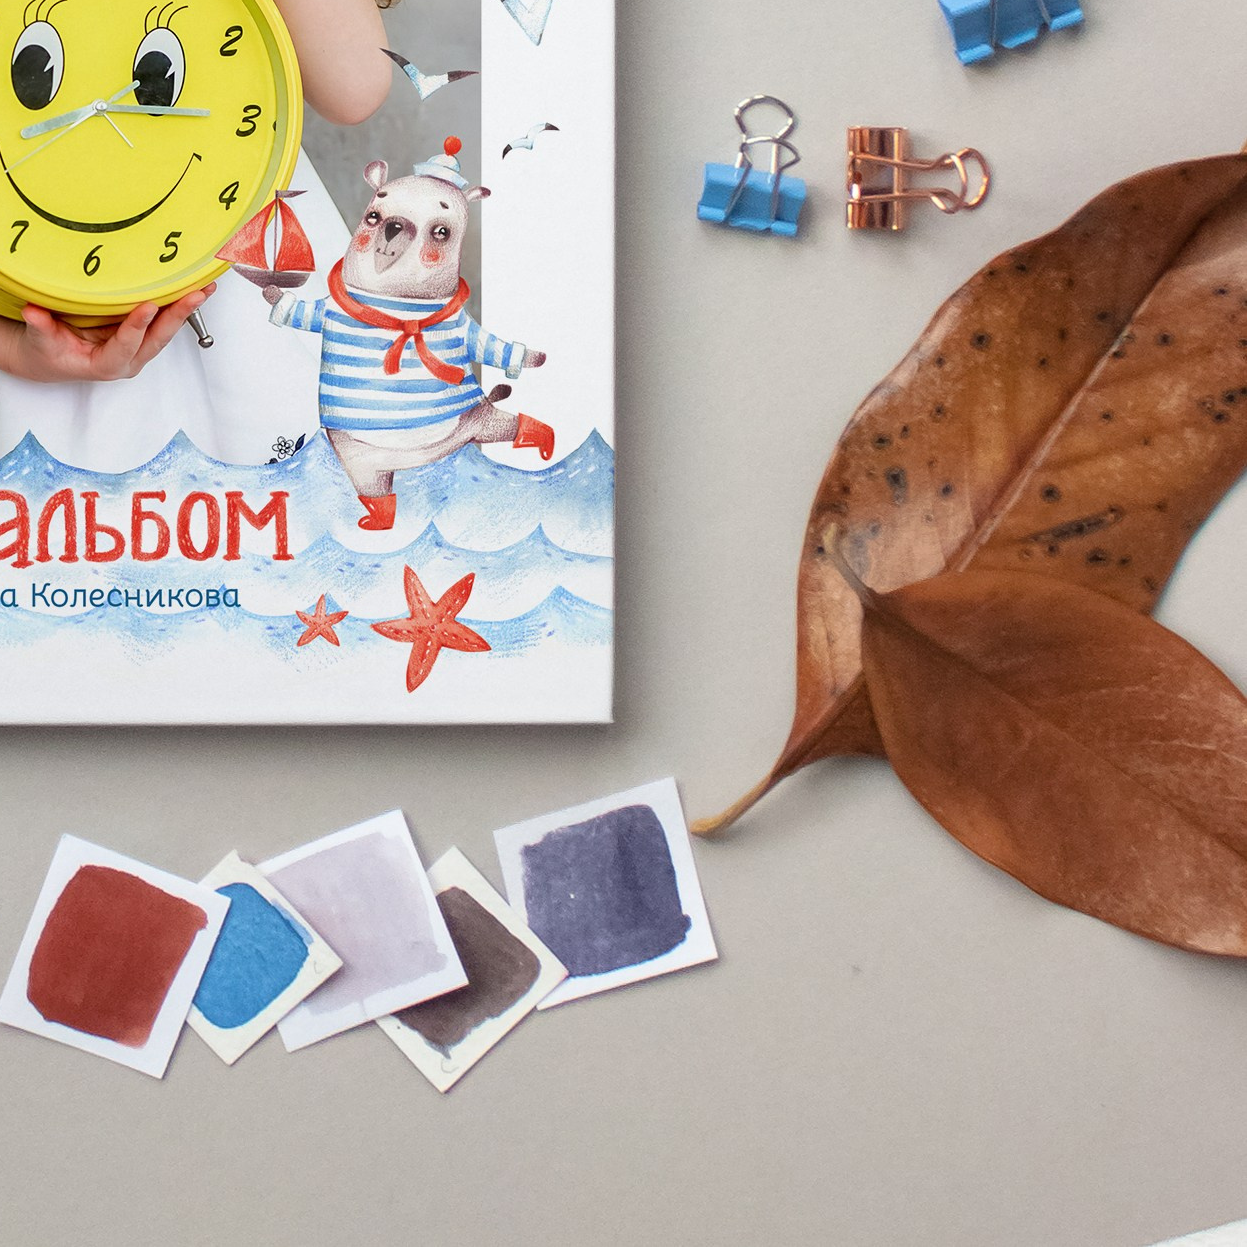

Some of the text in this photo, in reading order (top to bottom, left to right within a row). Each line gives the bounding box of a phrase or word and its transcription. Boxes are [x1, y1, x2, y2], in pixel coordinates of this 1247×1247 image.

[219, 25, 243, 57] 2
[235, 104, 262, 138] 3
[218, 181, 240, 211] 4
[10, 220, 30, 254] 7
[159, 231, 182, 263] 5
[83, 244, 103, 277] 6
[31, 582, 242, 609] Колесникова
